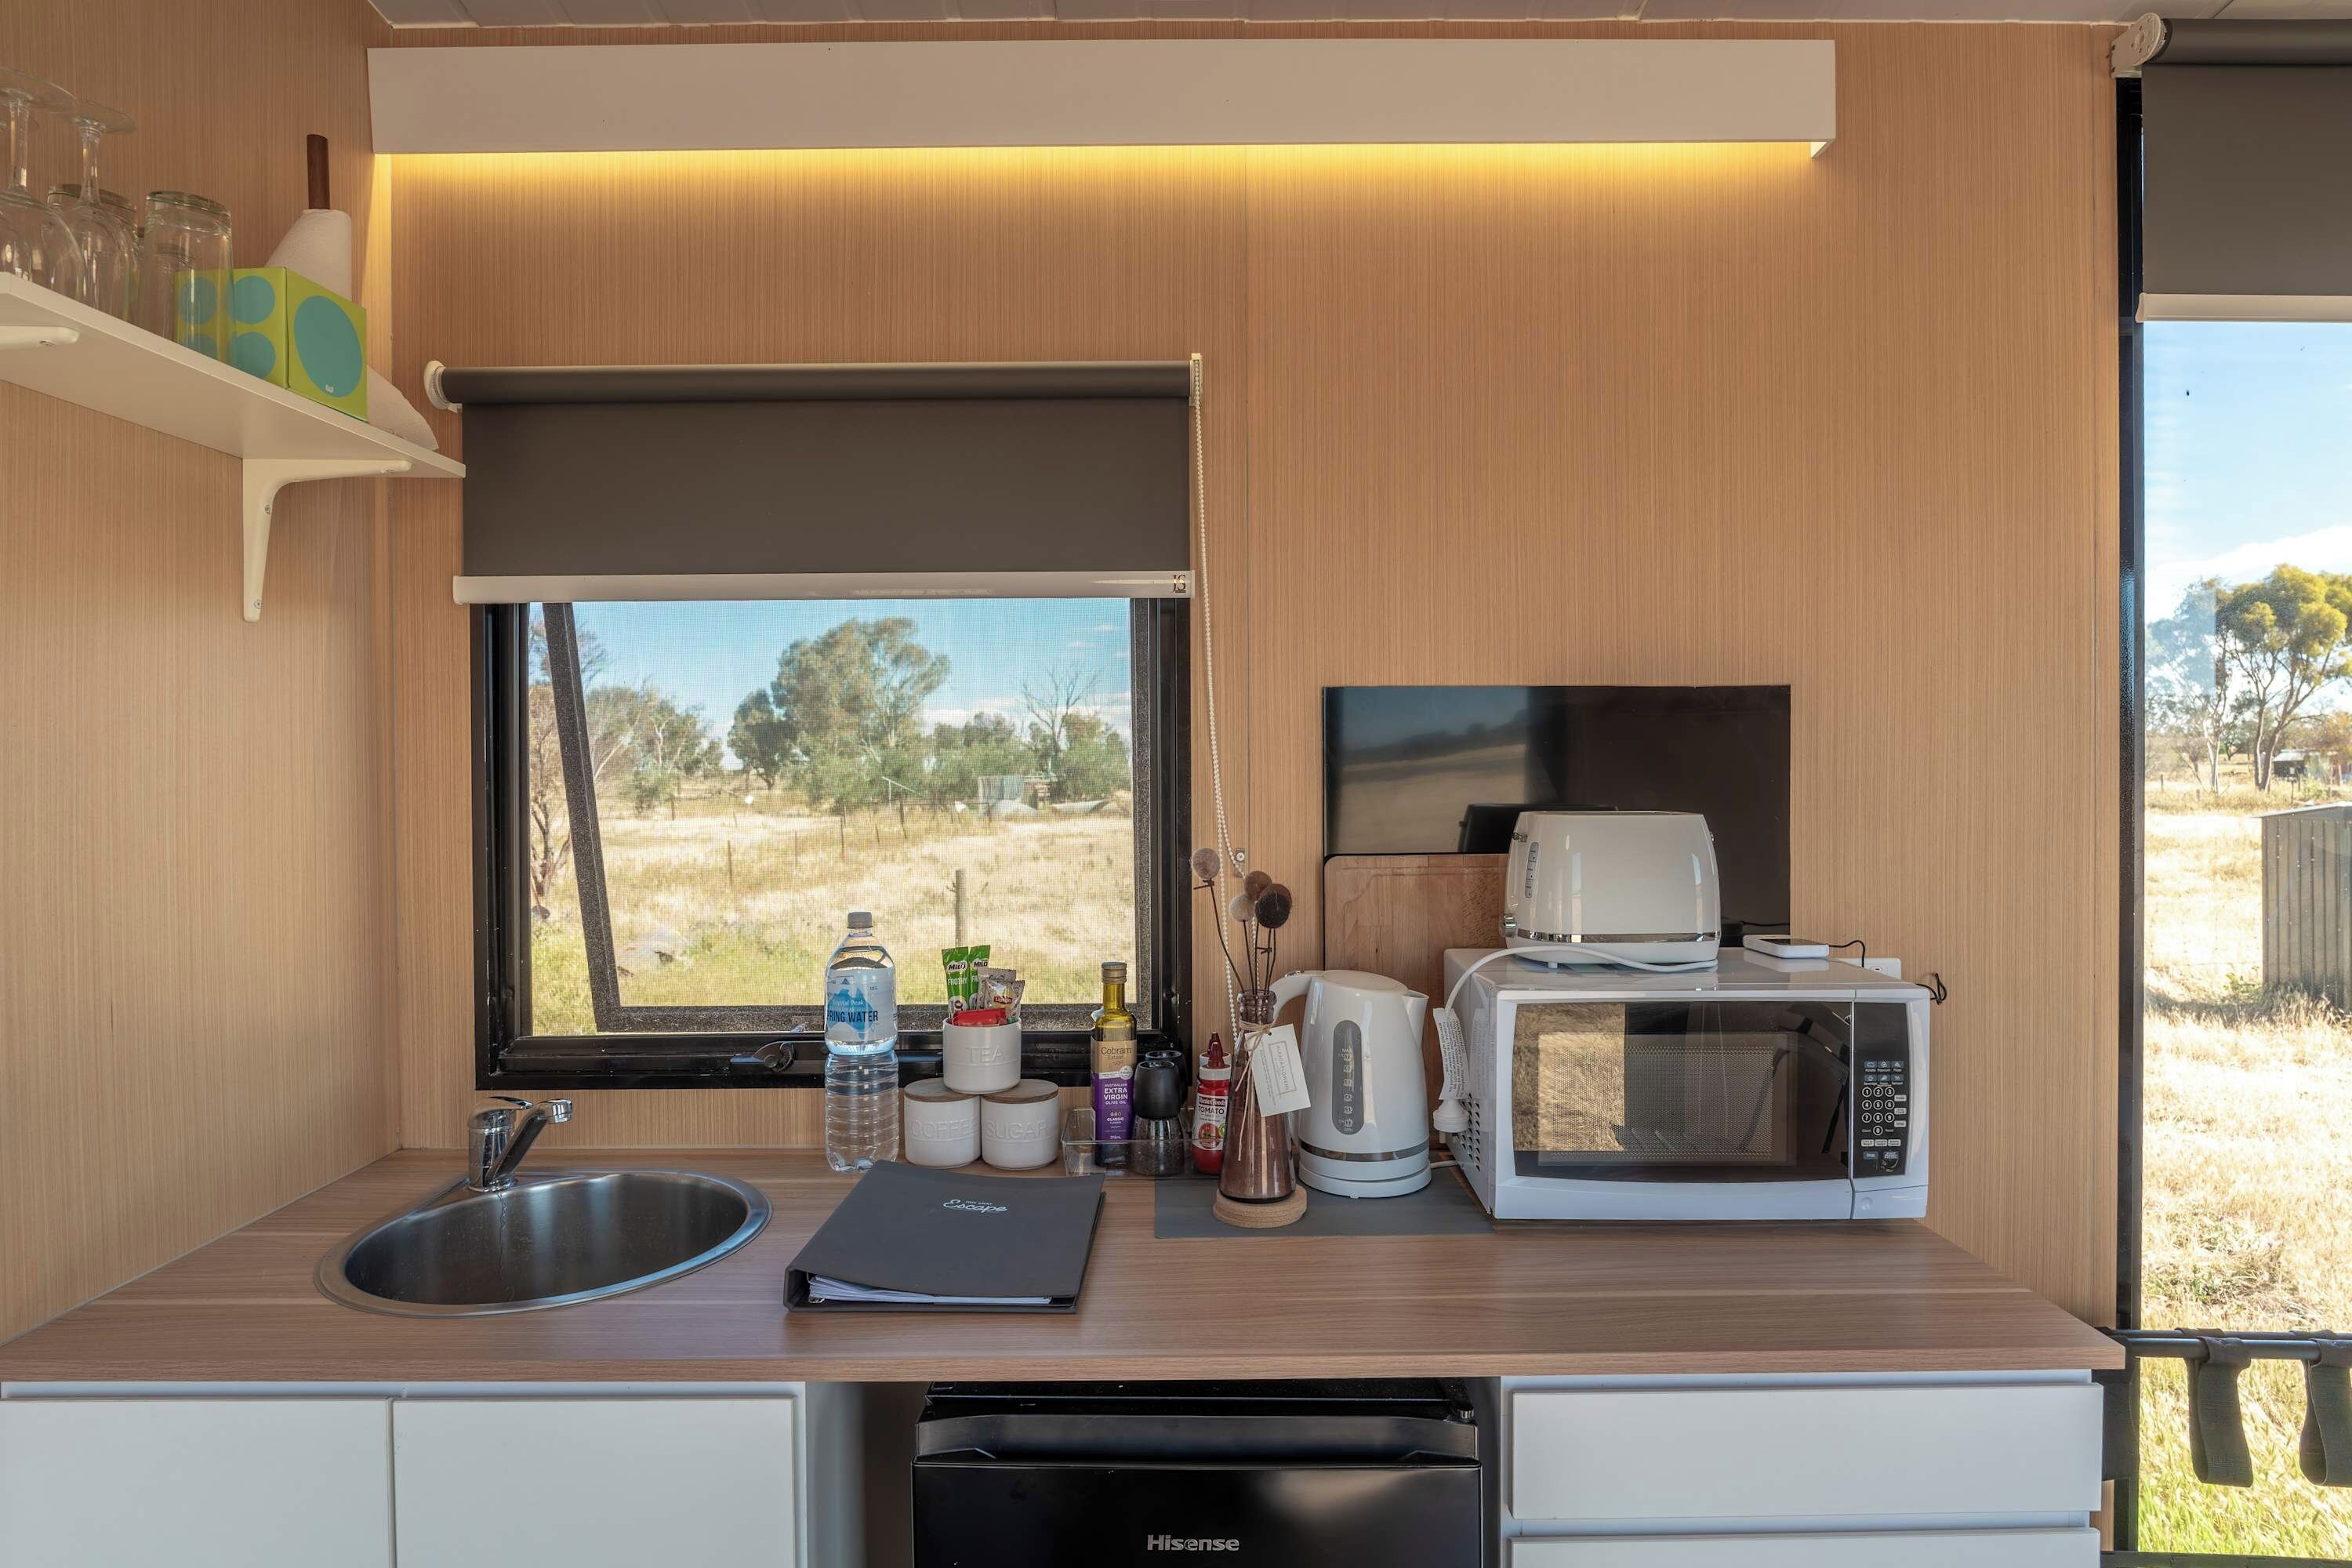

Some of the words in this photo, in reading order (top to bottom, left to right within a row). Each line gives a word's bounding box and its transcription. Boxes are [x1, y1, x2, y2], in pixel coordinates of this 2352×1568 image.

[848, 1010, 878, 1022] WATER
[966, 1047, 1004, 1063] TEA
[1198, 1105, 1225, 1115] TOMATO
[911, 1117, 979, 1137] COFFEE
[985, 1120, 1048, 1138] SUGAR
[943, 1199, 1007, 1213] Escape
[1147, 1534, 1240, 1552] Hisense
